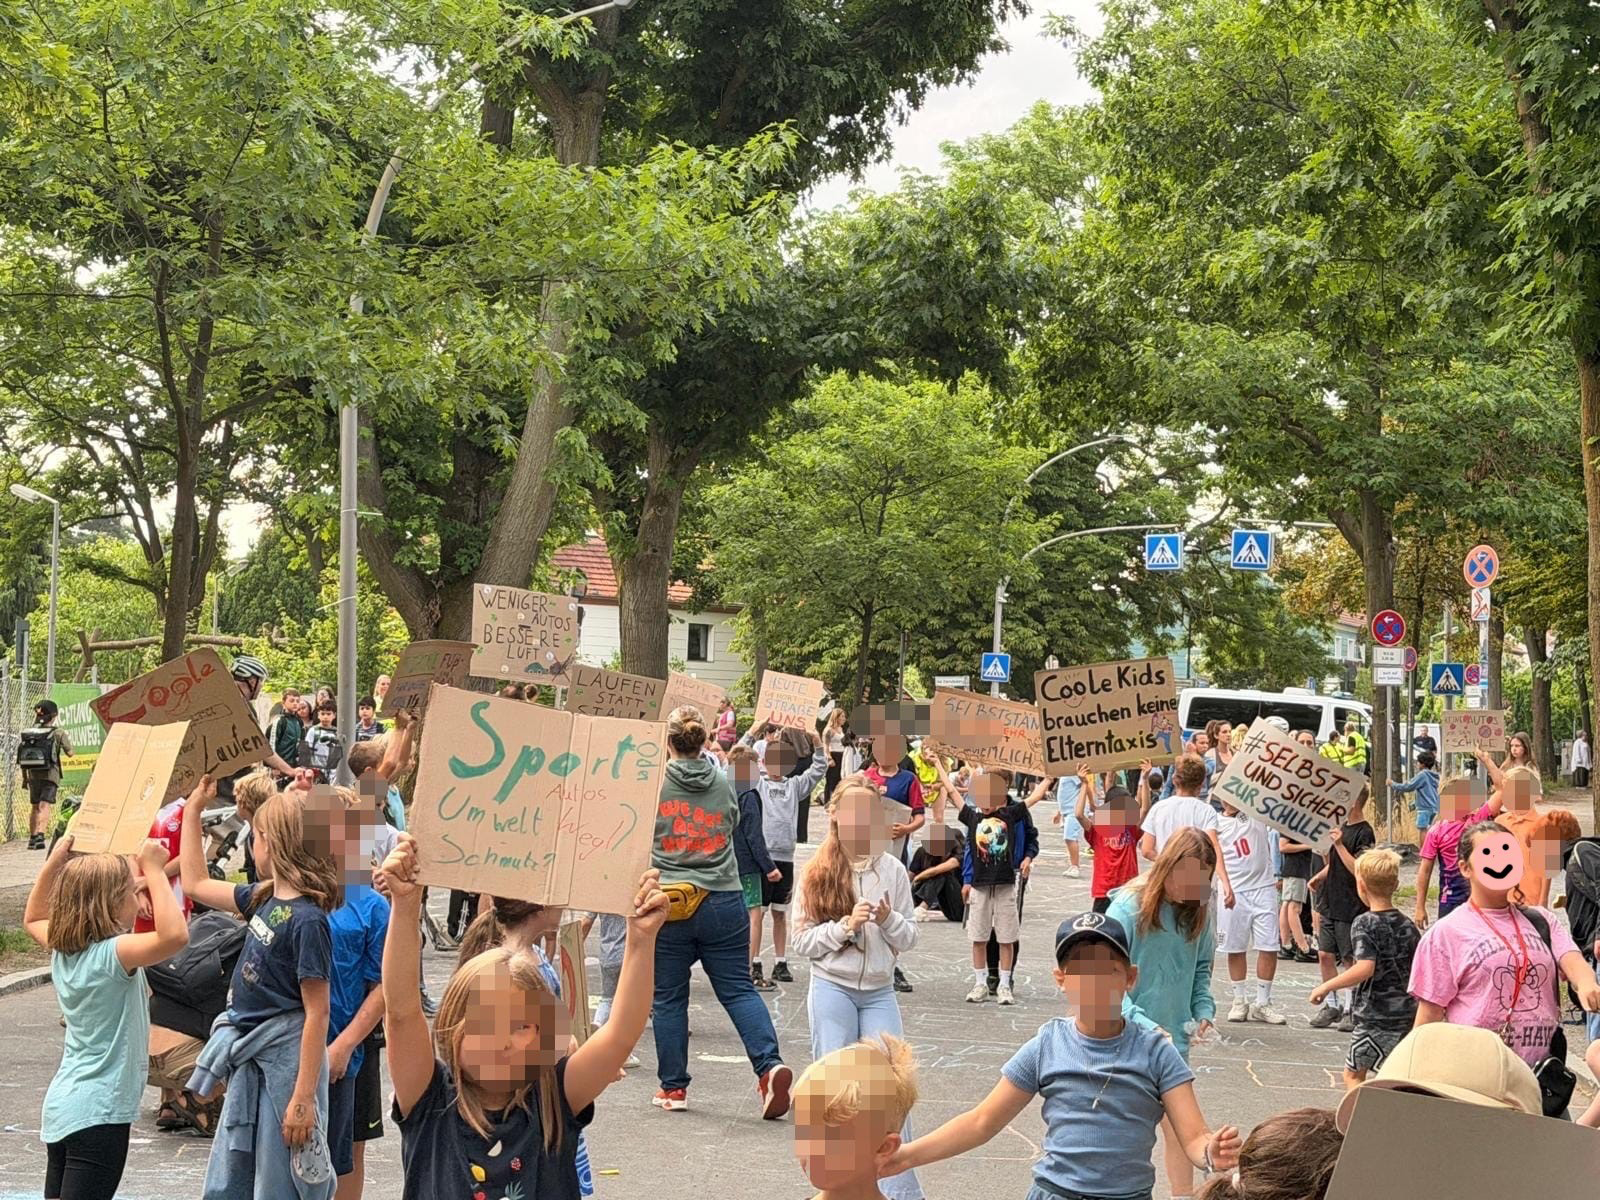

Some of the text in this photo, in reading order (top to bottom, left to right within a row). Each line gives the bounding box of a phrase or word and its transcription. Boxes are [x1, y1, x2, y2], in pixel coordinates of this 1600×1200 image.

[479, 589, 548, 613] WENIGER
[483, 623, 560, 648] BESSERE
[531, 613, 572, 632] AUTOS
[507, 644, 540, 660] LUFT
[576, 669, 657, 697] LAUFEN
[1117, 662, 1166, 689] Kids
[595, 691, 644, 708] STATT
[1043, 693, 1178, 731] brauchen keine
[770, 711, 806, 728] UNS
[203, 724, 264, 774] Laufen
[449, 701, 636, 804] Sport
[1046, 730, 1158, 763] Elterntaxis
[1244, 730, 1350, 793] #SELBST
[546, 784, 607, 802] Autos
[1244, 761, 1347, 825] UND SICHER
[1222, 776, 1331, 843] ZUR SCHULE
[1233, 838, 1250, 858] 10
